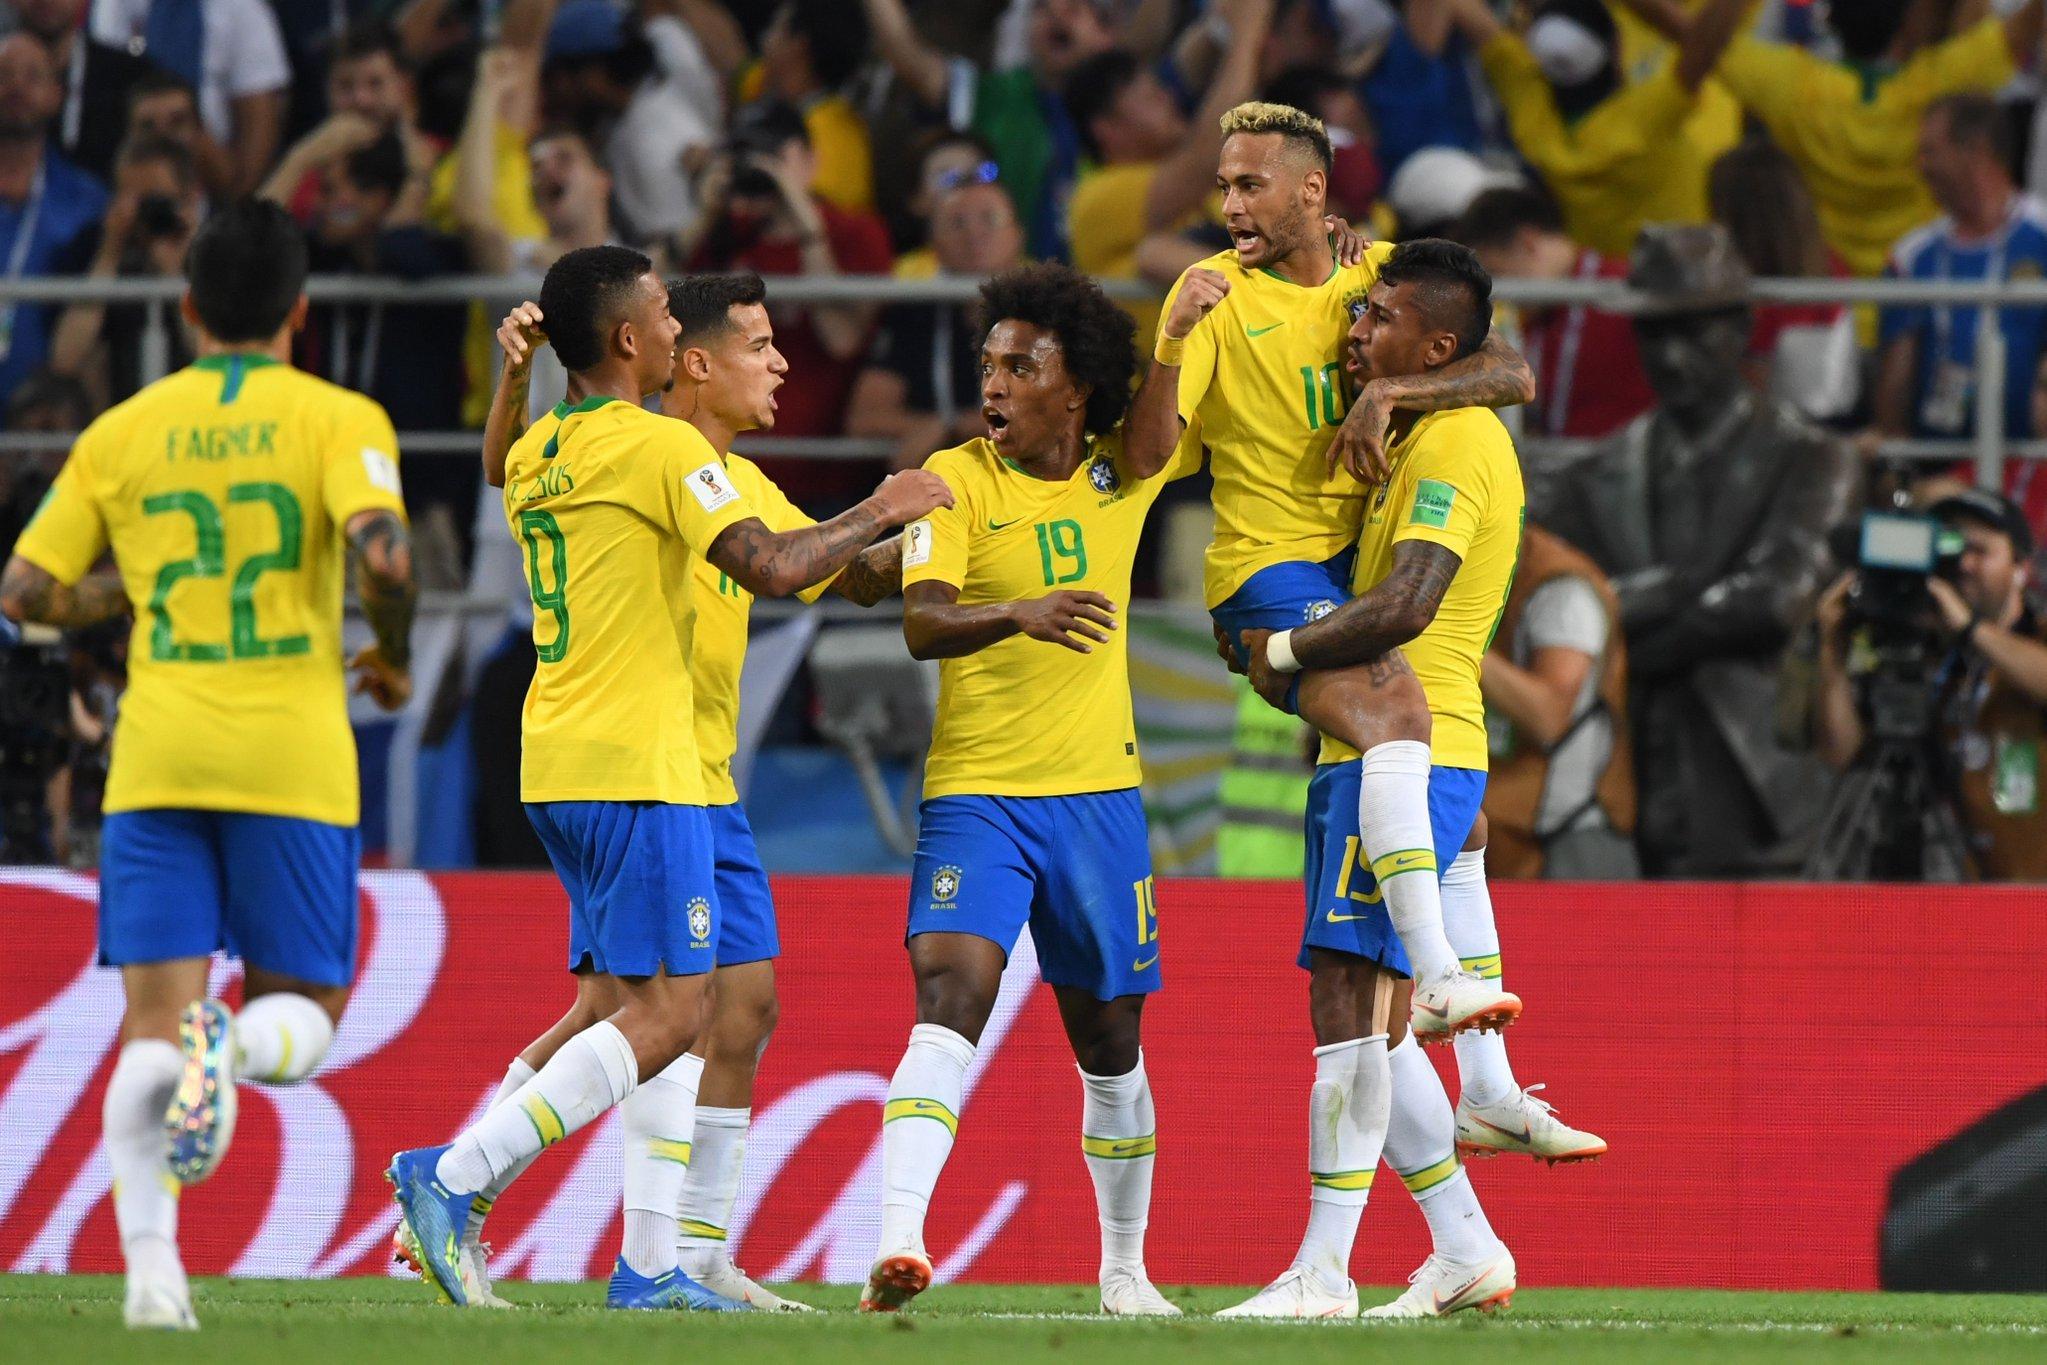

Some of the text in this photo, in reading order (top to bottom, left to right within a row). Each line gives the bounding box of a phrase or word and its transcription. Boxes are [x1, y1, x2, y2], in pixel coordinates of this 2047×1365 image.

[1301, 361, 1346, 430] 10
[142, 482, 311, 661] 22
[520, 509, 570, 663] 9
[1034, 518, 1087, 586] 19
[930, 902, 958, 910] BRASIL
[1133, 874, 1159, 945] 19
